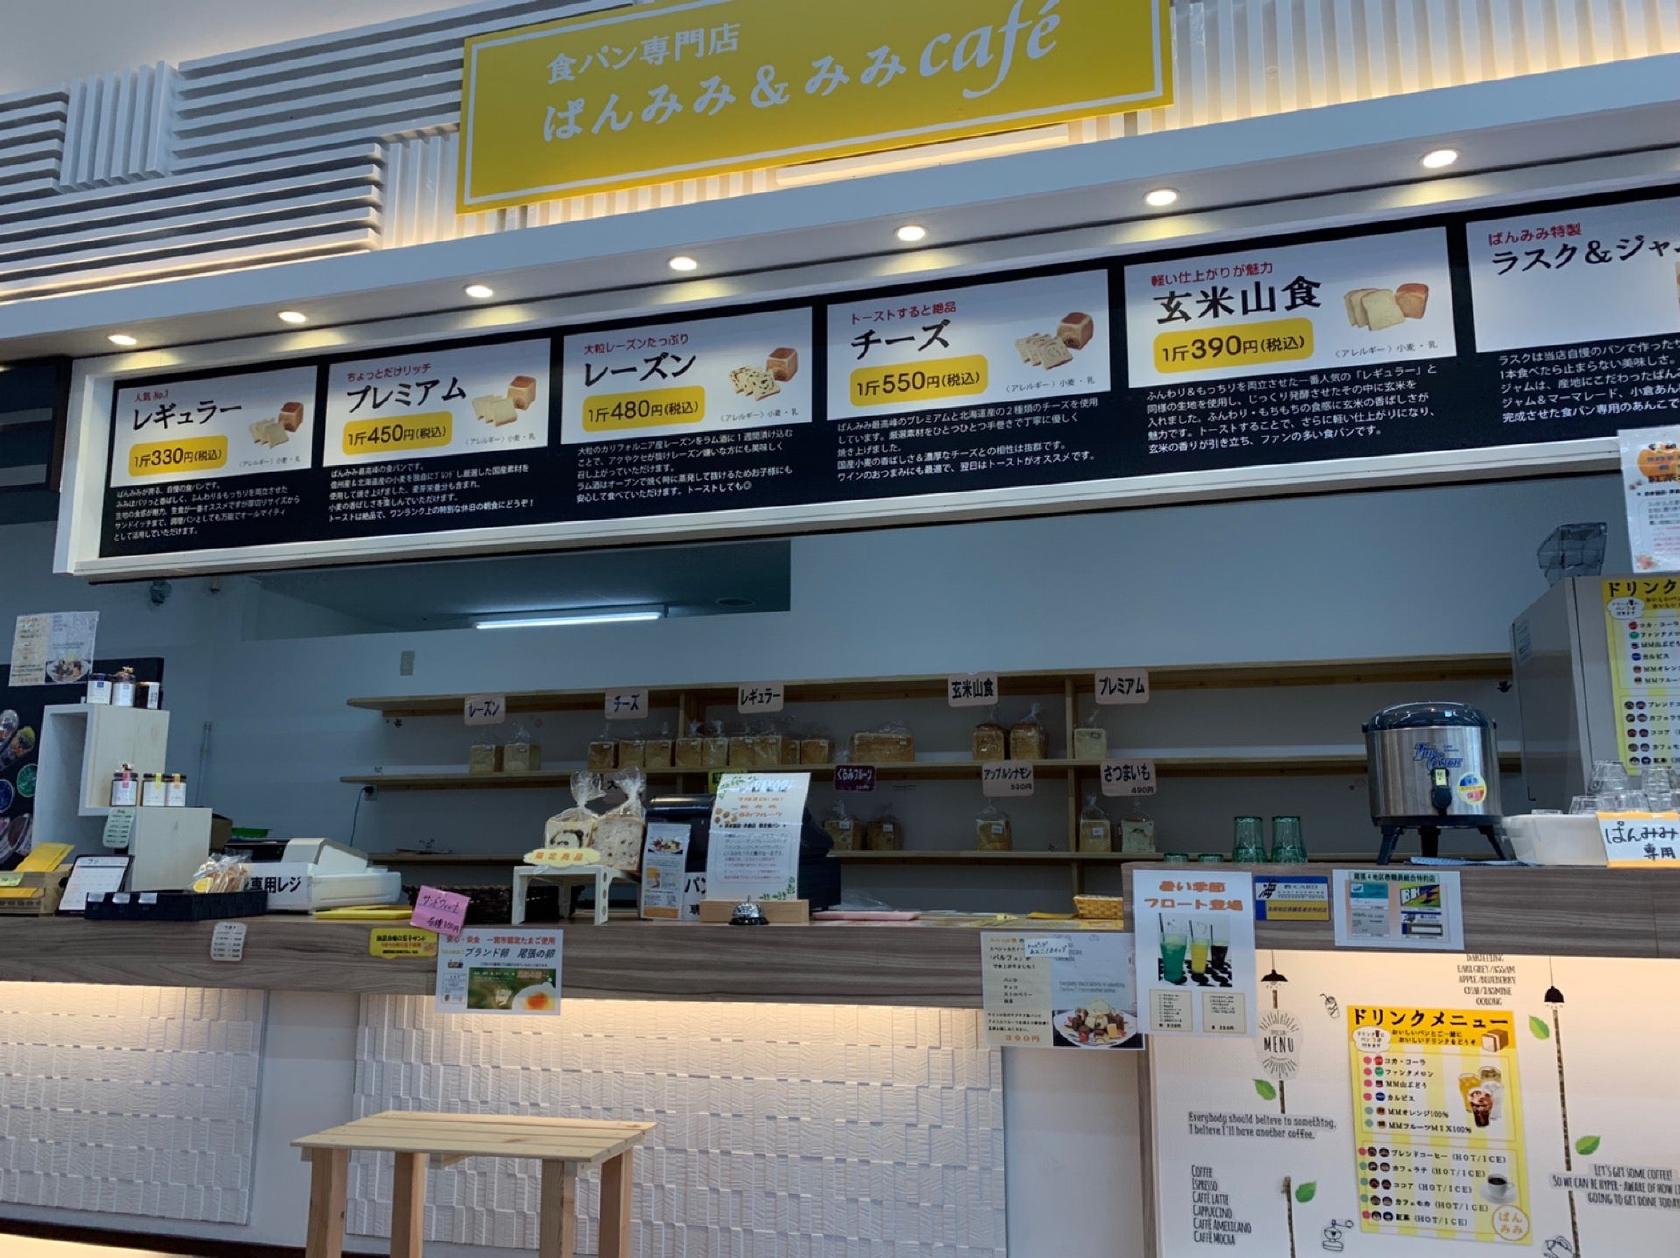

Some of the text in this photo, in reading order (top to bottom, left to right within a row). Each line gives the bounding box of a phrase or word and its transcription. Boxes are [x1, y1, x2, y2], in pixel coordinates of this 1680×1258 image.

[547, 23, 740, 83] 食パン専門店
[1151, 262, 1273, 287] 軽い仕上がりが魅力
[1153, 275, 1321, 325] 玄米山食
[851, 301, 957, 325] トーストすると絶品
[583, 333, 689, 355] 大粒レーズンたっぷり
[850, 319, 951, 360] チーズ
[347, 363, 432, 382] ちょっとだけリッチ
[584, 351, 697, 387] レーズン
[347, 377, 467, 413] プレミアム
[133, 400, 242, 431] レギュラー
[740, 687, 781, 705] レギュラー
[951, 678, 995, 700] 玄米山食
[1100, 677, 1146, 695] プレミアム
[468, 700, 499, 718] レーズン
[613, 695, 640, 712] チーズ
[1103, 765, 1151, 782] さつまいも
[1605, 821, 1679, 844] ぱんみみ
[1643, 843, 1677, 861] 専用
[1143, 898, 1244, 912] フロート登場
[1353, 1008, 1509, 1029] ドリンクメニュー
[1264, 1036, 1294, 1053] MENU
[1188, 1112, 1227, 1124] Everybody
[1229, 1114, 1253, 1124] should
[1256, 1127, 1285, 1138] another
